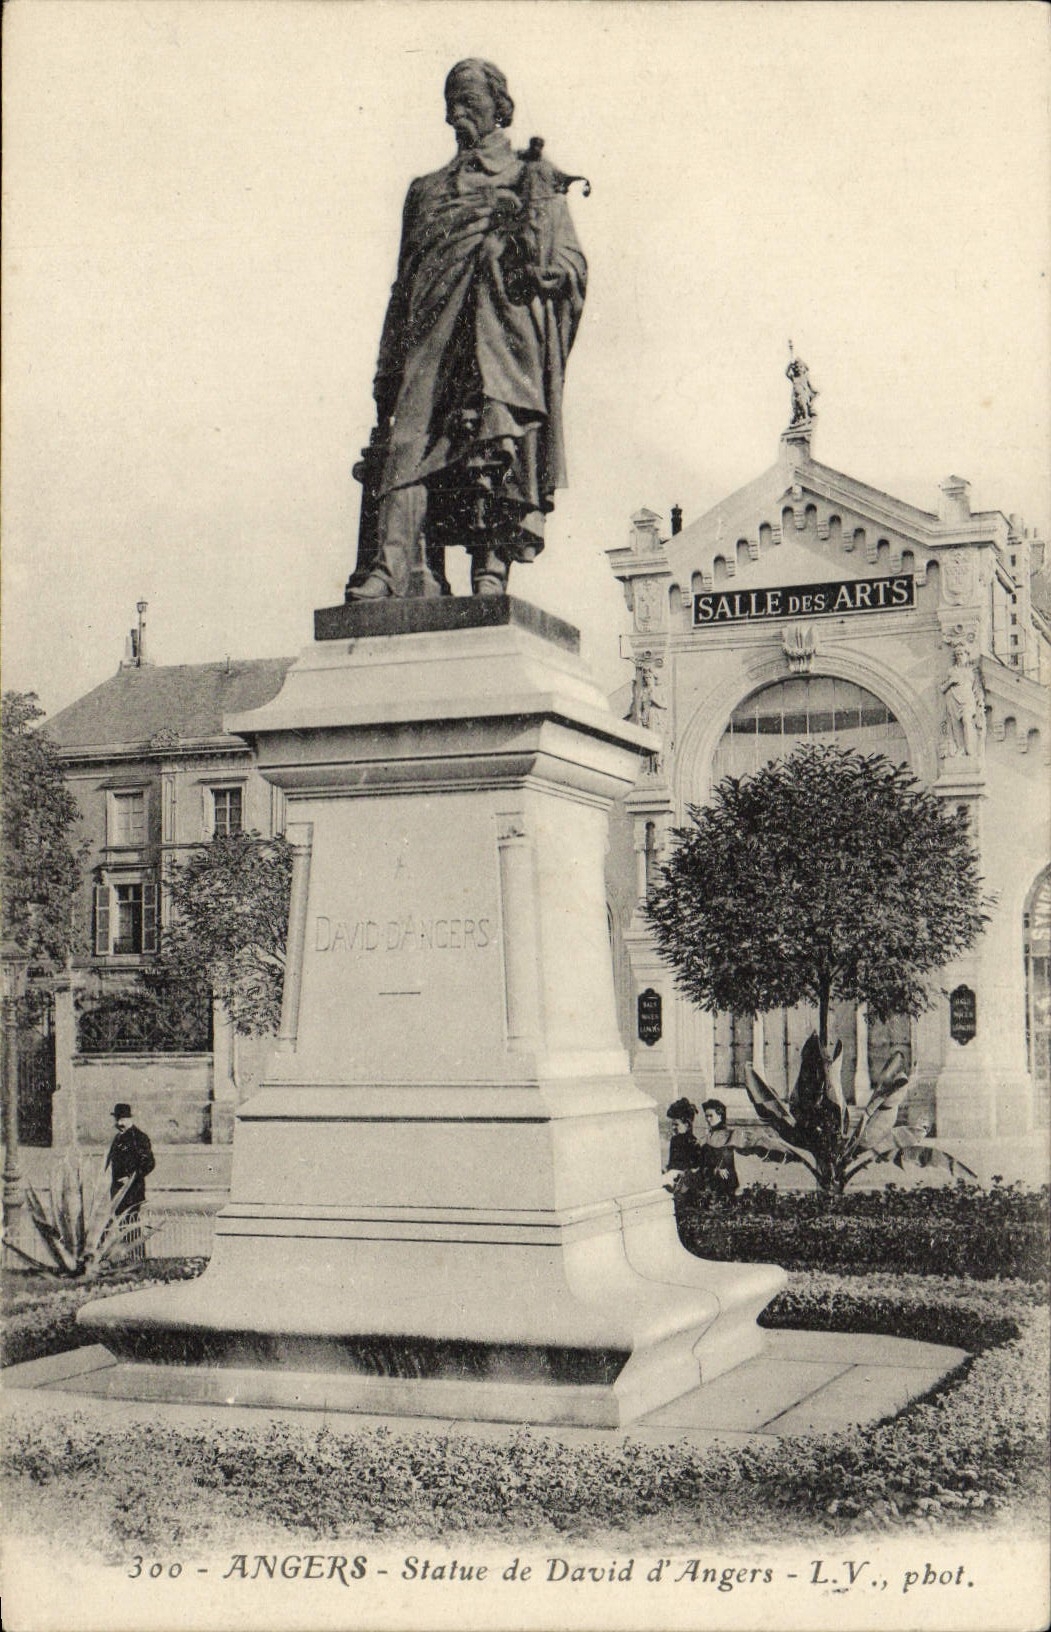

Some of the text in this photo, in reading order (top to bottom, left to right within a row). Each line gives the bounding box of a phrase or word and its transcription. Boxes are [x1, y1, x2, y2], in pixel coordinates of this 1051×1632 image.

[699, 579, 910, 621] SALLE DES ARTS
[314, 916, 377, 952] DAVID
